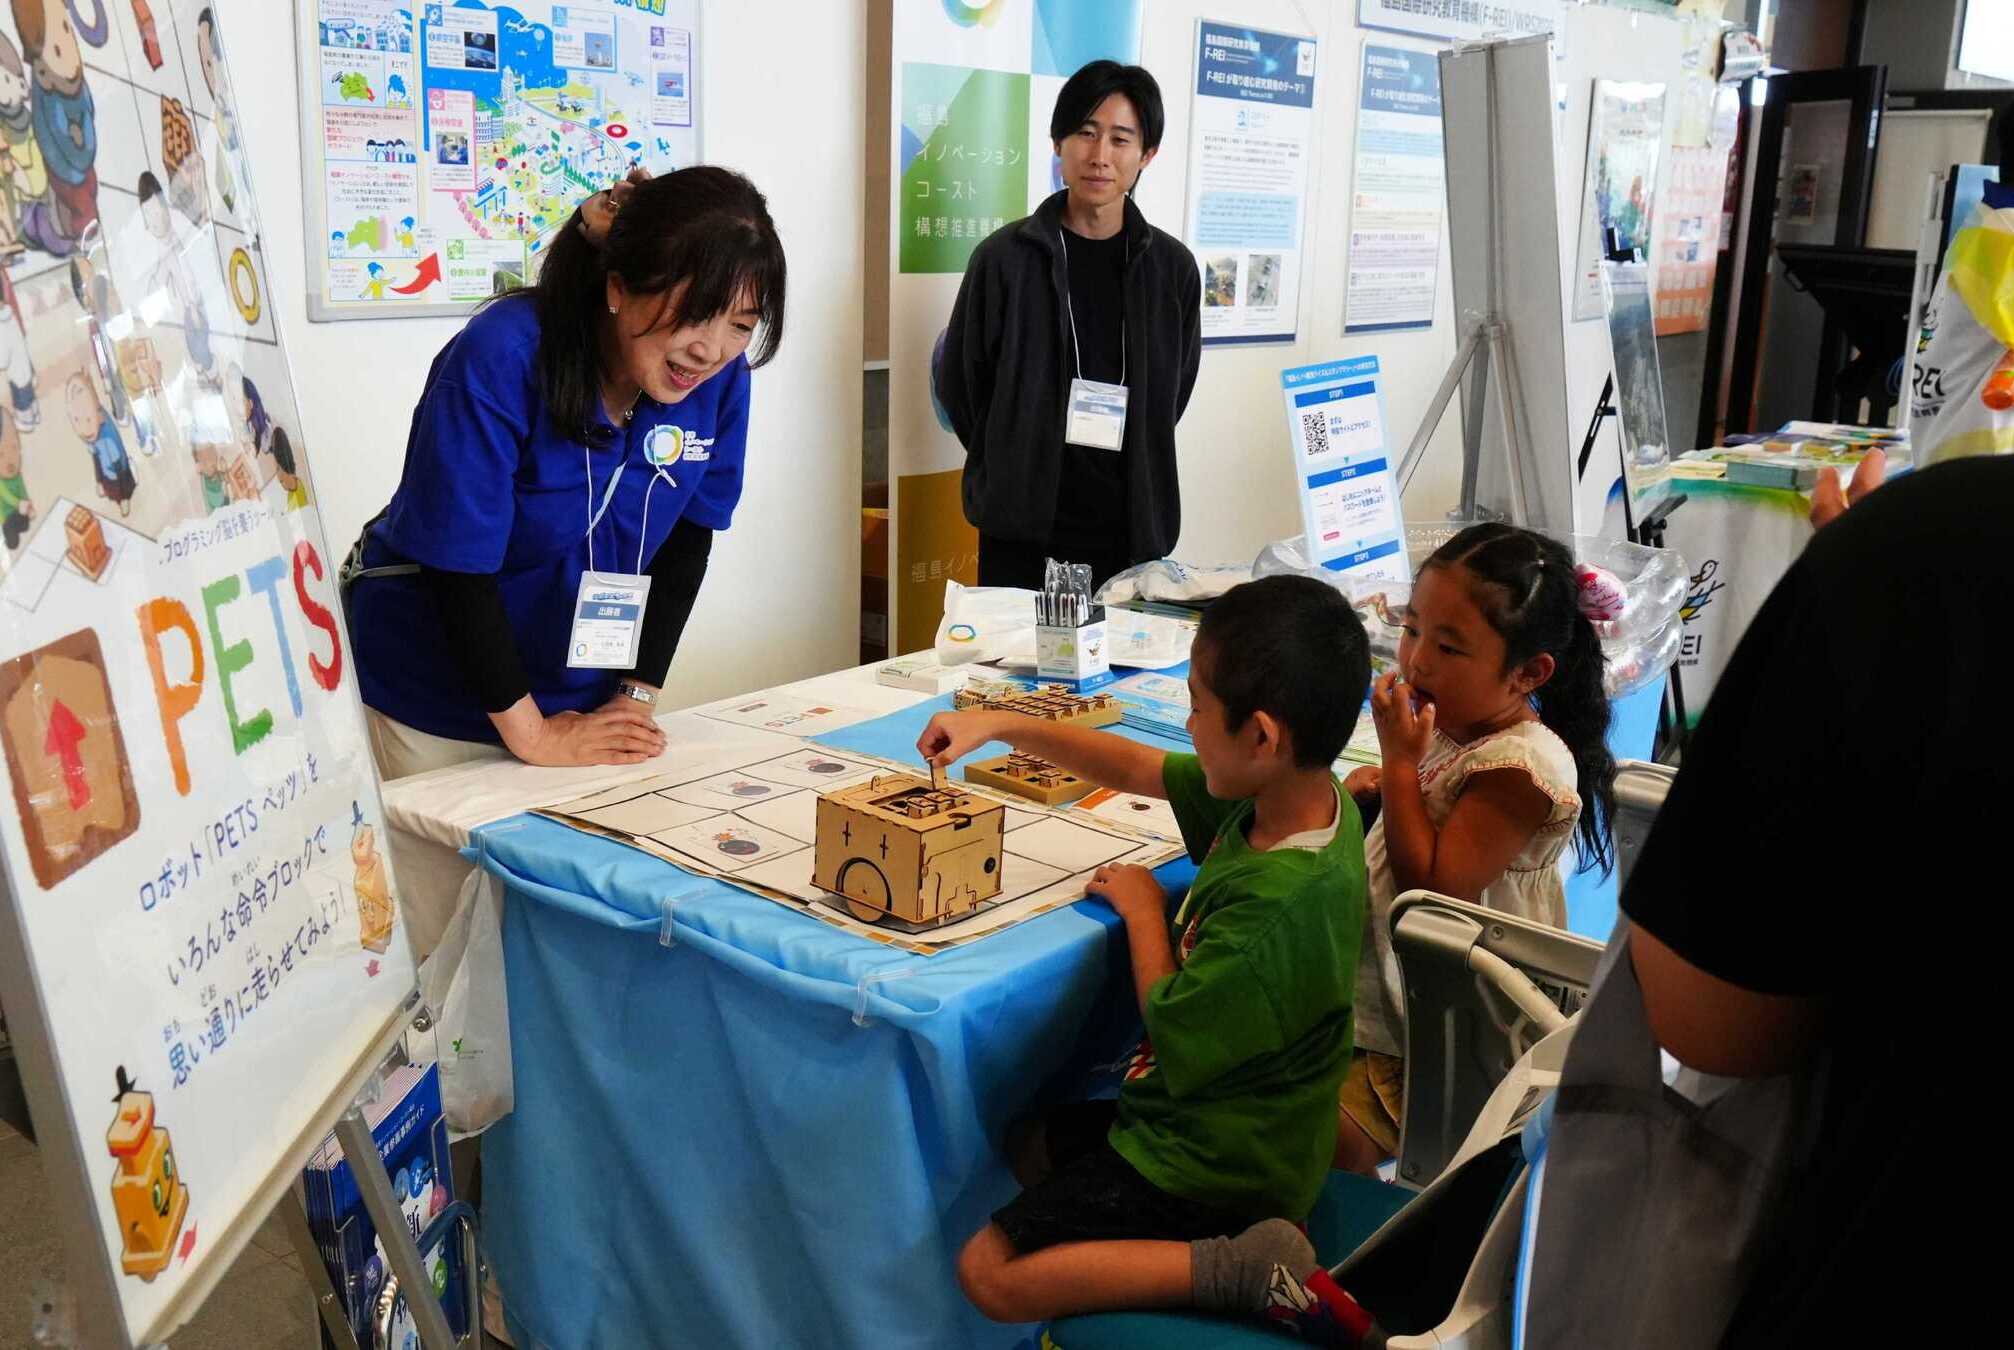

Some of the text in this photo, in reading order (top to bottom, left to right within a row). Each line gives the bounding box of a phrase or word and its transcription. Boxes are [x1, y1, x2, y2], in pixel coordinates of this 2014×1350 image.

[915, 143, 1021, 165] イノベーション
[916, 180, 977, 200] コースト
[137, 540, 342, 797] PETS
[167, 825, 327, 987] いろんな命令ブロックで
[168, 881, 347, 1090] 思い通りに走らせてみよう!
